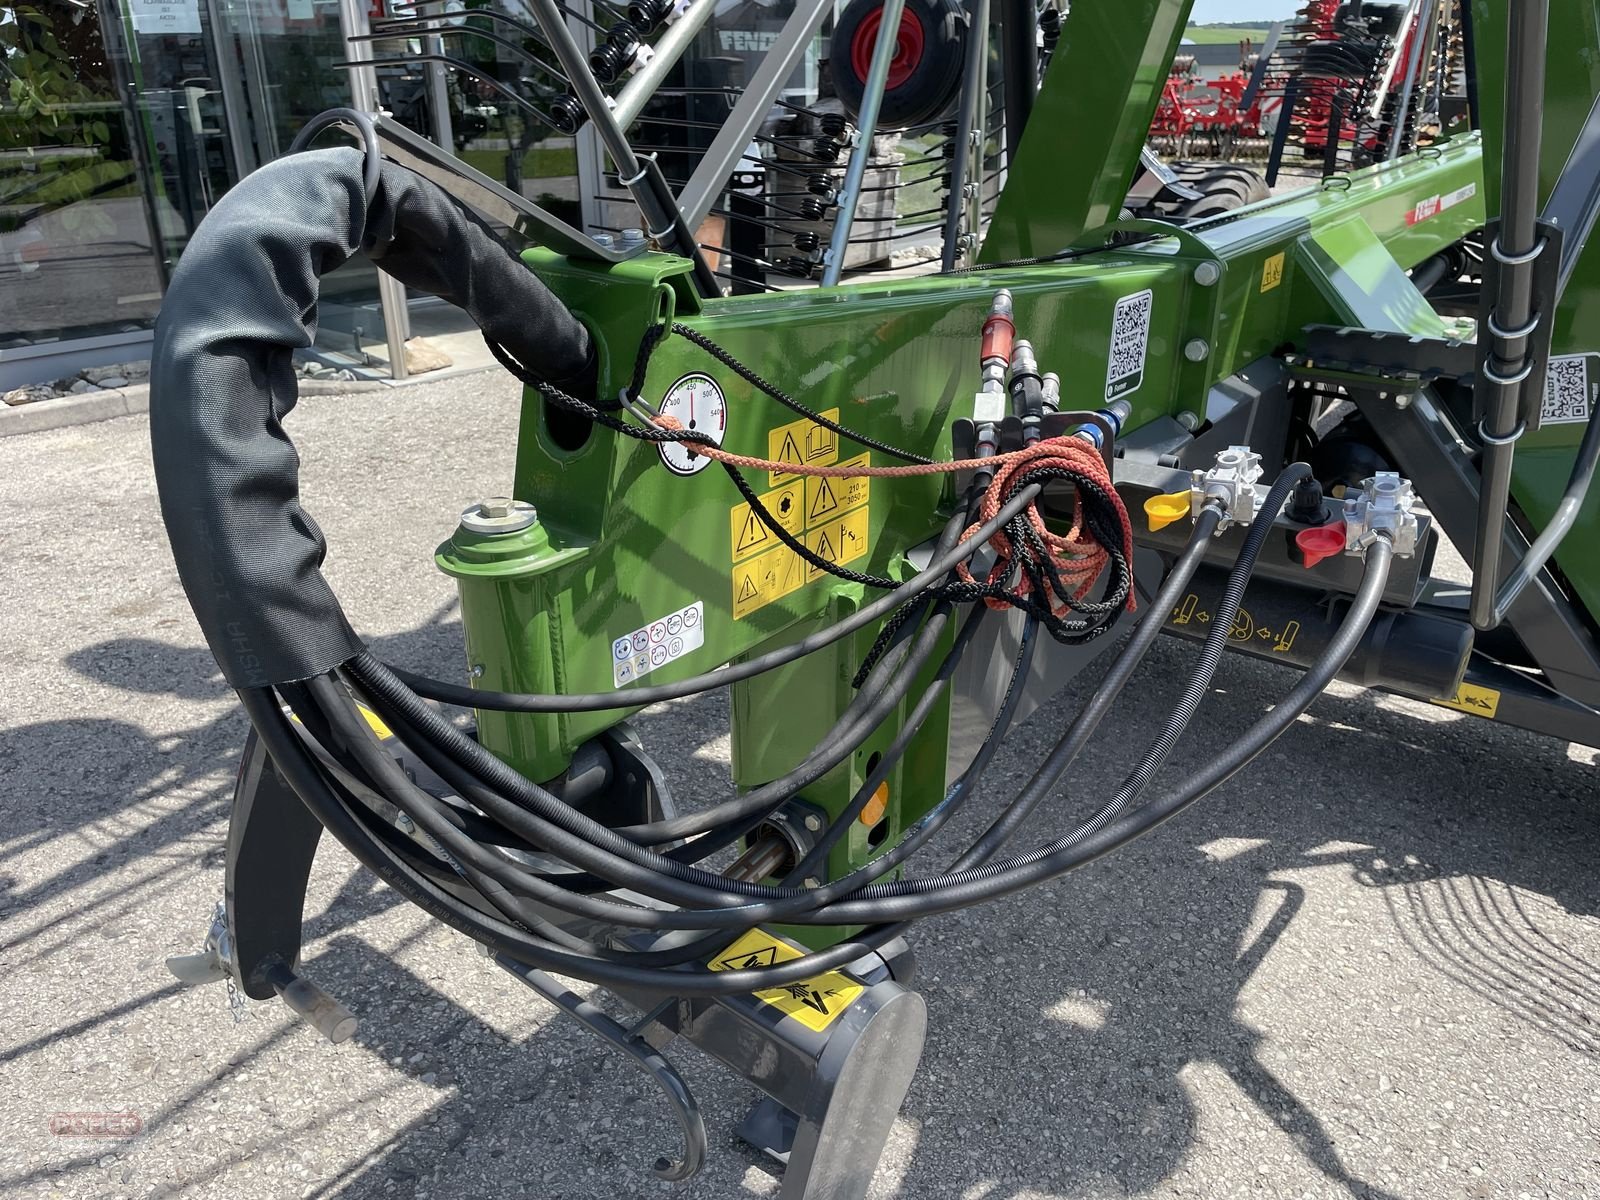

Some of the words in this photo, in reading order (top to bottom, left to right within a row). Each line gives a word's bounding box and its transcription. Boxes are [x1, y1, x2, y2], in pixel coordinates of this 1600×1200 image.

[719, 30, 780, 52] FEND
[1121, 331, 1139, 345] FENDT
[686, 383, 697, 391] 450
[702, 389, 713, 398] 500
[1547, 376, 1556, 407] FENDT
[669, 397, 681, 406] 400
[710, 408, 721, 417] 540
[848, 482, 860, 494] 210
[847, 492, 862, 505] 3050
[226, 621, 267, 687] MSHA
[381, 865, 394, 878] AIR
